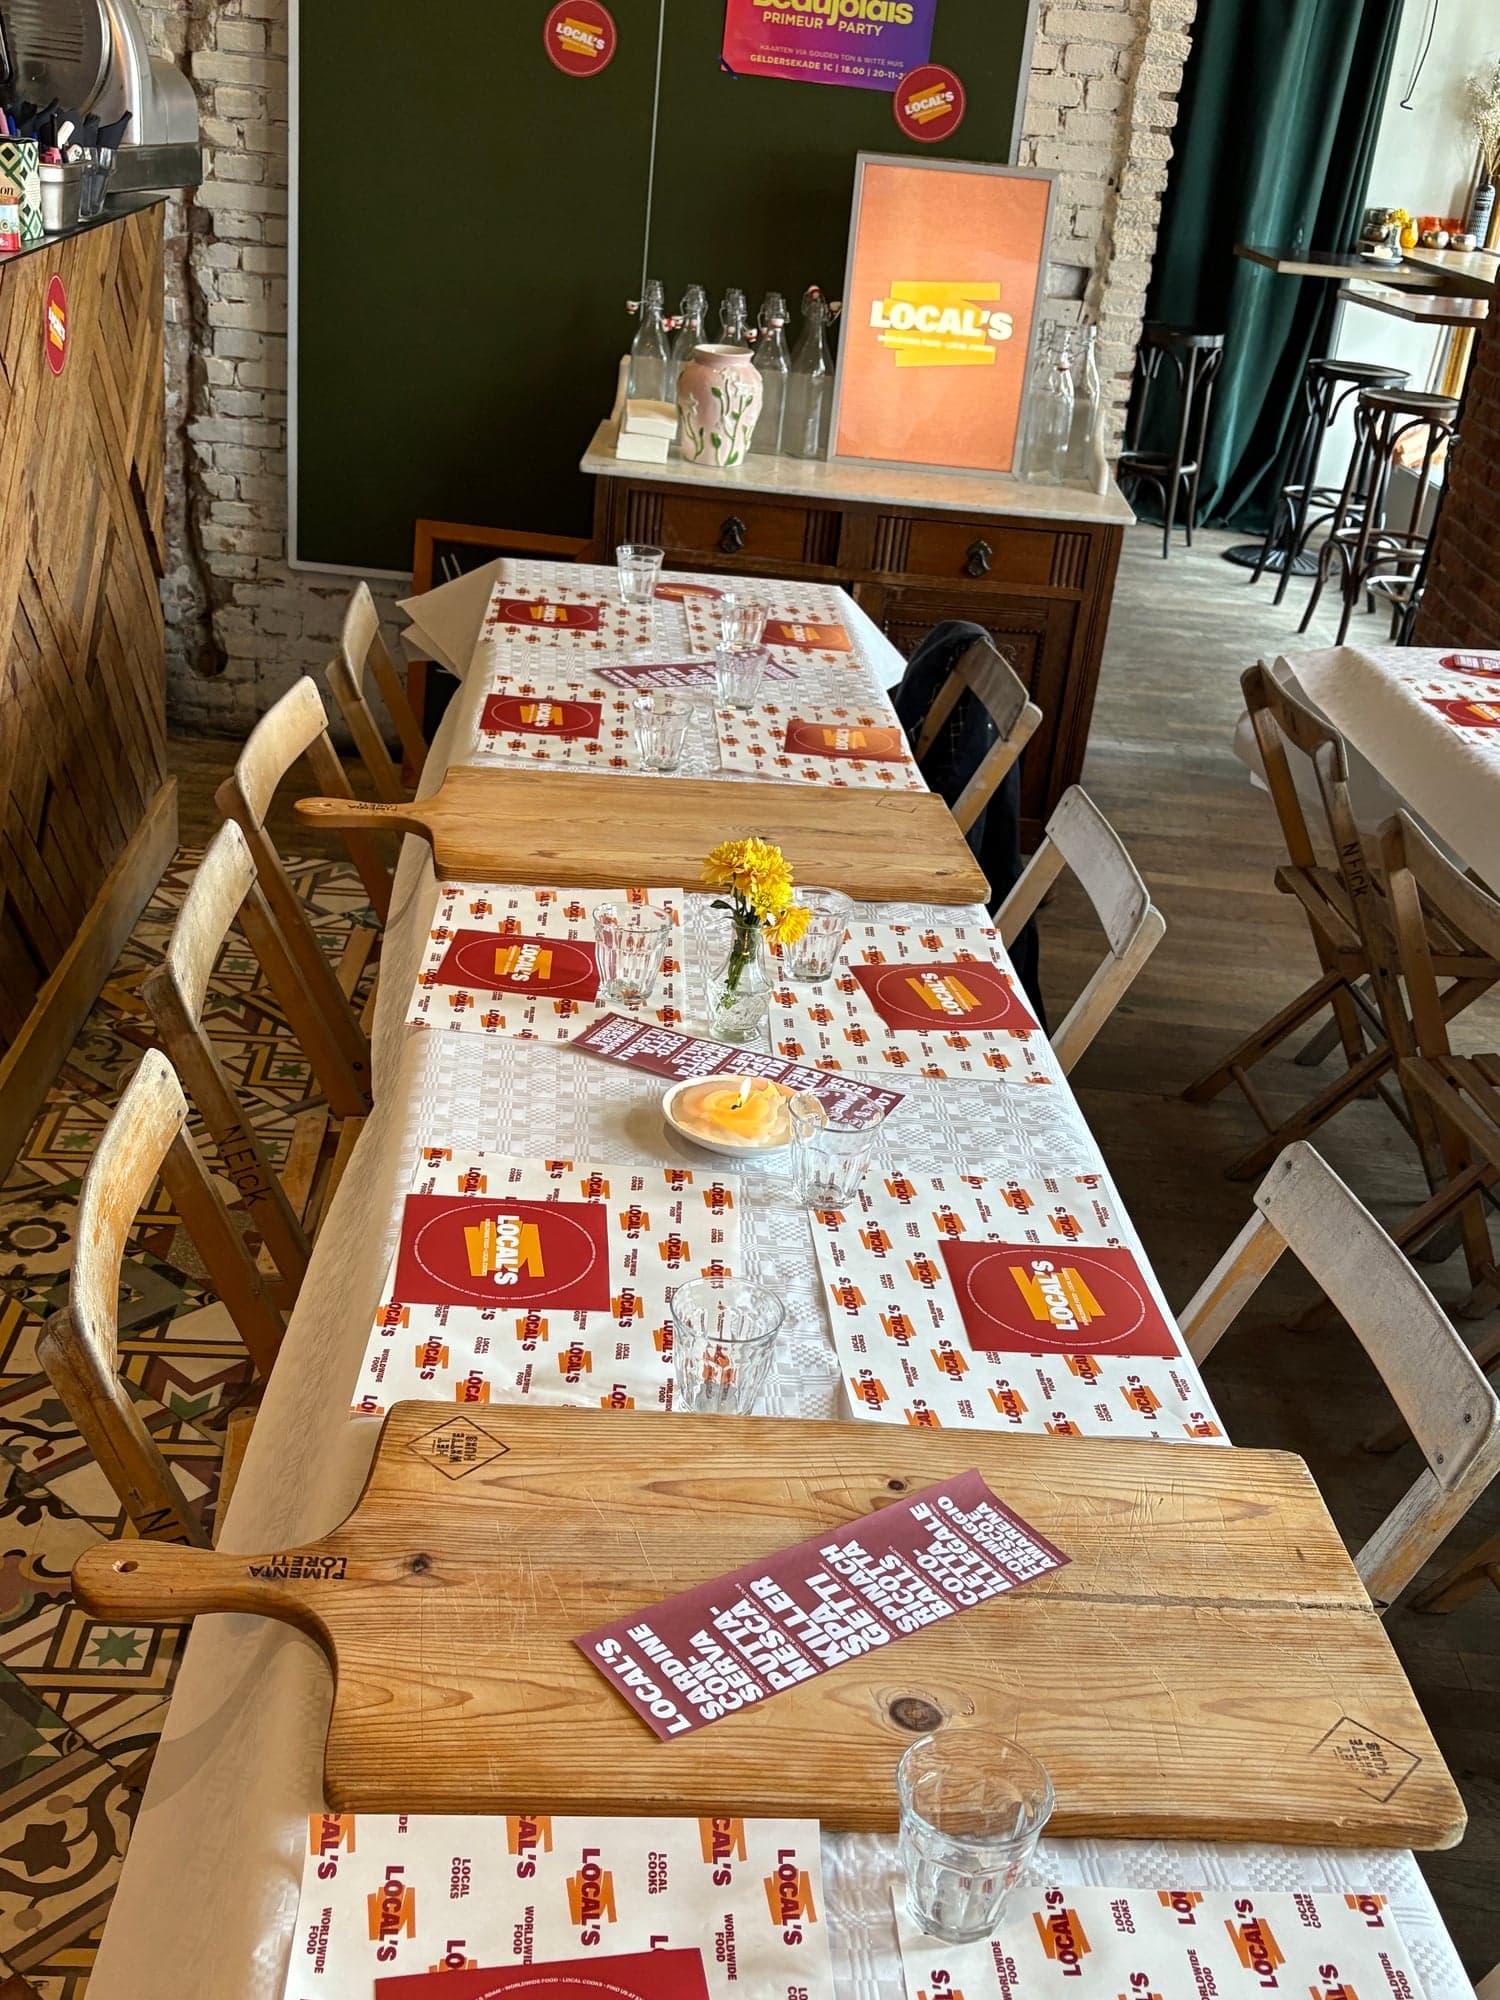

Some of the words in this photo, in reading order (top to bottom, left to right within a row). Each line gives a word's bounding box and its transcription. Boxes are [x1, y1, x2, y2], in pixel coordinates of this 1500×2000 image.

[556, 22, 605, 50] LOCAL'S
[763, 11, 823, 29] PRIMEUR
[838, 21, 883, 37] PARTY
[750, 54, 821, 70] GELDERSEKADE
[823, 63, 833, 71] 1C
[841, 65, 865, 75] 18.00
[809, 49, 839, 60] GOUDEN
[841, 53, 856, 62] TON
[904, 91, 955, 116] LOCAL'S
[870, 300, 1013, 340] LOCAL'S
[511, 944, 540, 982] LOCAL'S
[921, 972, 965, 1016] LOCAL'S
[638, 1030, 676, 1054] LETTA
[650, 1034, 689, 1058] COTO-
[668, 1039, 709, 1065] BALLS
[736, 1055, 776, 1077] SPA
[711, 1182, 724, 1216] LOCAL'S
[891, 1171, 911, 1205] LOCAL'S
[1007, 1181, 1029, 1215] LOCAL'S
[627, 1204, 641, 1239] LOCAL'S
[866, 1221, 886, 1258] LOCAL'S
[940, 1204, 960, 1240] LOCAL'S
[1054, 1206, 1078, 1242] LOCAL'S
[494, 1215, 520, 1285] LOCAL'S
[630, 1248, 638, 1277] WORLDWIDE
[667, 1232, 681, 1270] LOCAL'S
[914, 1252, 936, 1290] LOCAL'S
[619, 1287, 635, 1328] LOCAL'S
[839, 1276, 859, 1317] LOCAL'S
[927, 1299, 941, 1328] WORLDWIDE
[936, 1307, 945, 1321] FOOD
[1031, 1260, 1079, 1330] LOCAL'S
[522, 1309, 542, 1351] LOCAL'S
[851, 1335, 860, 1352] LOCAL
[857, 1334, 867, 1353] COOKS
[888, 1304, 909, 1347] LOCAL'S
[420, 1335, 443, 1380] LOCAL'S
[474, 1336, 483, 1354] COOKS
[482, 1338, 491, 1354] LOCAL
[566, 1341, 584, 1383] LOCAL'S
[938, 1339, 963, 1382] LOCAL'S
[371, 1356, 380, 1373] FOOD
[376, 1348, 390, 1383] WORLDWIDE
[516, 1372, 524, 1386] FOOD
[522, 1364, 533, 1394] WORLDWIDE
[900, 1358, 915, 1387] WORLDWIDE
[910, 1366, 919, 1380] FOOD
[658, 1386, 666, 1403] FOOD
[859, 1369, 882, 1412] LOCAL'S
[996, 1379, 1022, 1424] LOCAL'S
[1036, 1368, 1052, 1400] WORLDWIDE
[1046, 1377, 1056, 1392] FOOD
[1127, 1375, 1157, 1420] LOCAL'S
[1169, 1370, 1188, 1401] WORLDWIDE
[1180, 1378, 1192, 1393] FOOD
[965, 1510, 984, 1522] E
[909, 1502, 1013, 1595] ILLEGALE
[937, 1495, 1034, 1581] FORMAGGIO
[975, 1501, 1058, 1573] AMARENA
[978, 1516, 1045, 1578] FRESCO
[249, 1566, 346, 1579] PIMENTA
[271, 1556, 347, 1569] LORETI
[912, 1547, 979, 1605] COTO-
[927, 1537, 997, 1600] LETTA
[819, 1543, 920, 1633] SPINACH
[842, 1539, 938, 1628] RICOTTA
[878, 1550, 955, 1620] BALLS
[749, 1575, 850, 1667] KILLER
[805, 1569, 891, 1648] GETTI
[730, 1598, 818, 1681] NESCA
[808, 1599, 870, 1658] SPA
[689, 1629, 764, 1702] SERVA
[709, 1606, 797, 1691] PUTTA-
[595, 1638, 692, 1734] LOCAL'S
[626, 1623, 725, 1720] SARDINE
[688, 1655, 744, 1710] CON-
[450, 1857, 461, 1899] COOKS
[460, 1858, 471, 1898] LOCAL
[648, 1852, 658, 1895] COOKS
[658, 1853, 668, 1894] LOCAL
[377, 1866, 404, 1962] LOCAL'S
[581, 1848, 601, 1946] LOCAL'S
[777, 1849, 803, 1946] LOCAL'S
[1110, 1900, 1126, 1932] LOCAL
[1045, 1890, 1082, 1977] LOCAL'S
[1118, 1899, 1136, 1934] COOKS
[306, 1925, 319, 1955] FOOD
[314, 1907, 332, 1974] WORLDWIDE
[513, 1924, 523, 1955] FOOD
[715, 1932, 725, 1963] FOOD
[724, 1913, 737, 1981] WORLDWIDE
[1234, 1898, 1279, 1989] LOCAL'S
[582, 1978, 603, 1987] COOKS
[990, 1941, 1013, 2000] WORLDWIDE
[1005, 1956, 1020, 1985] FOOD
[1202, 1967, 1219, 1997] FOOD
[1395, 1970, 1414, 2000] FOOD
